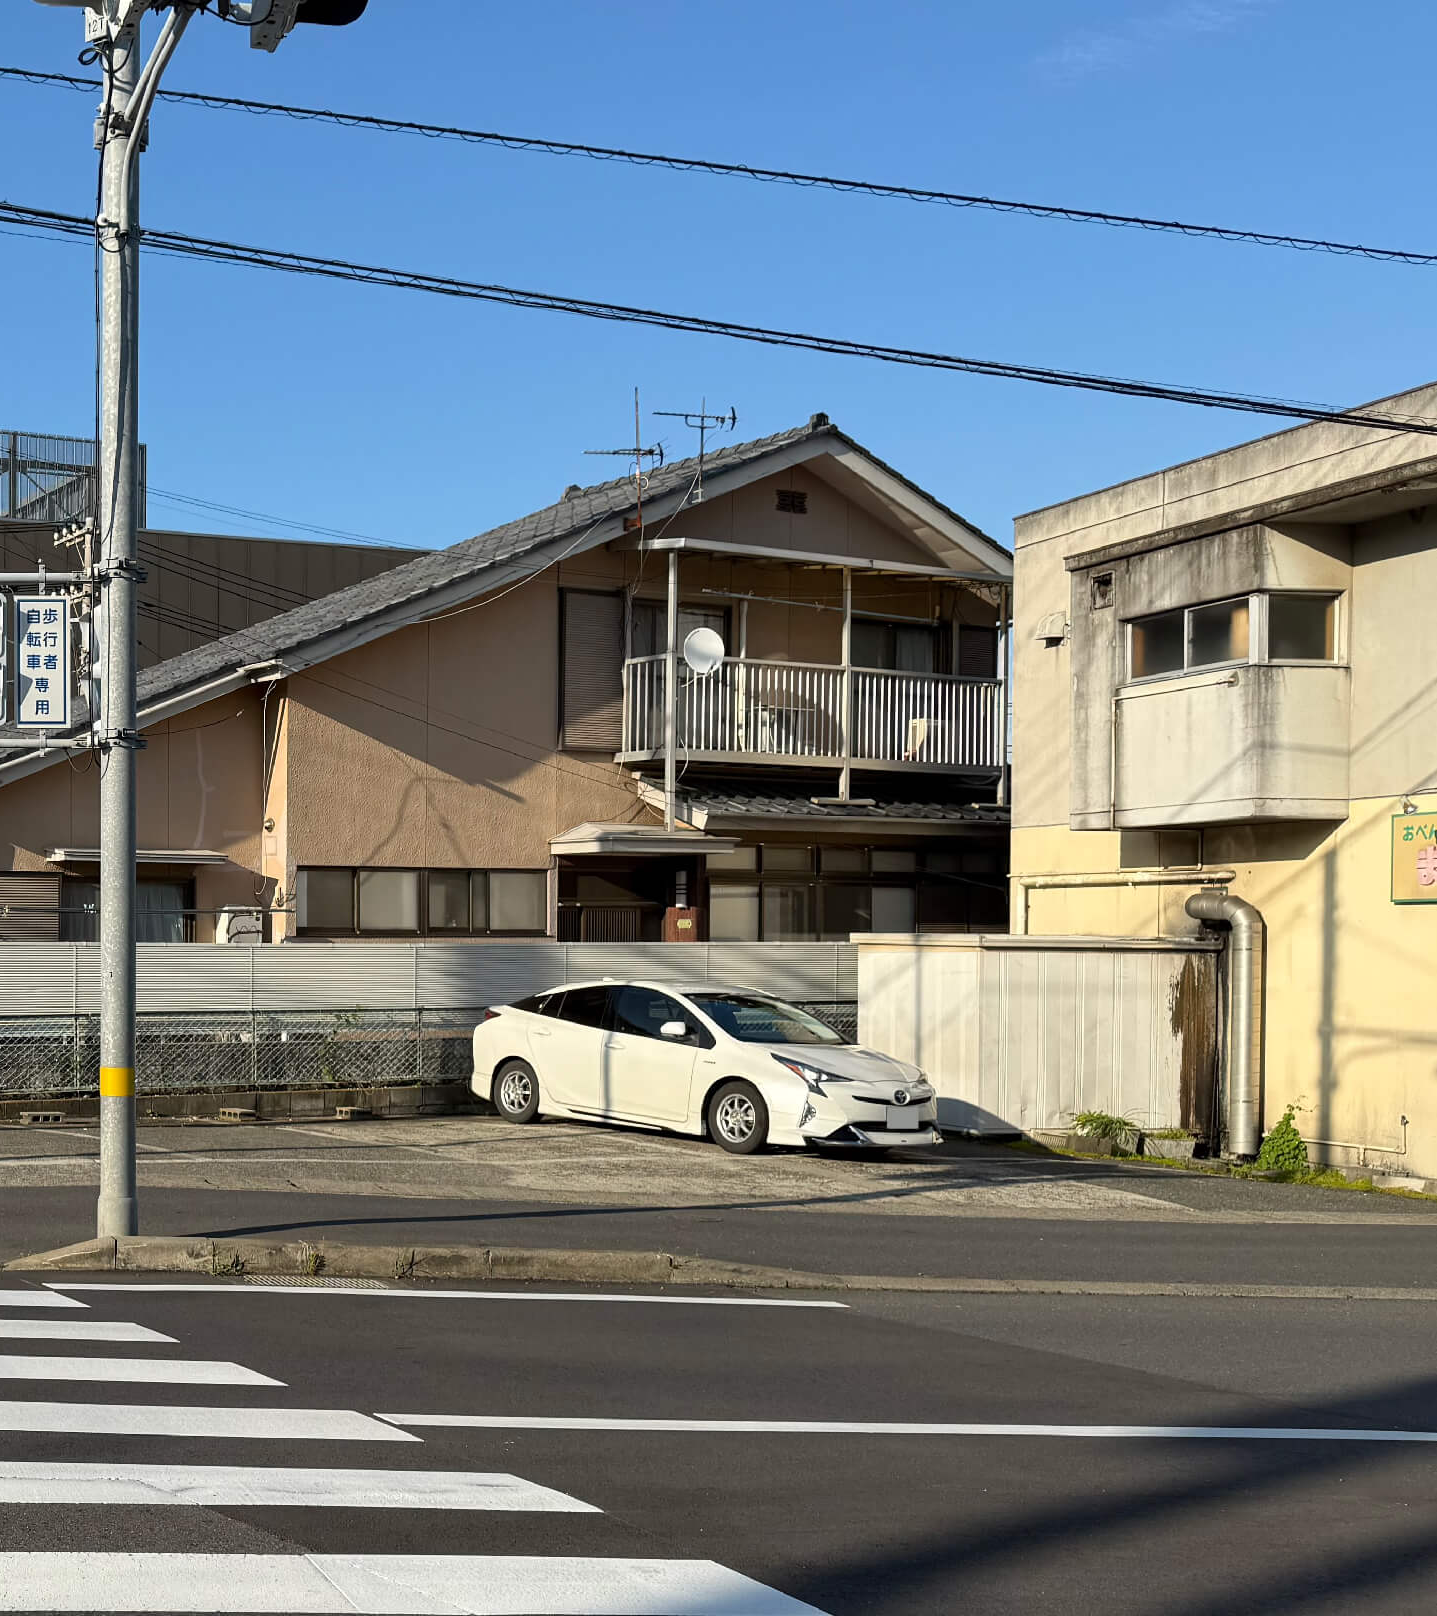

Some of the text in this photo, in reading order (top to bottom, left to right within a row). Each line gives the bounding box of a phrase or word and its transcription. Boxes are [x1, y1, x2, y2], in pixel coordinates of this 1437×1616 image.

[26, 609, 42, 669] 自転車
[43, 608, 58, 670] 歩行者
[35, 677, 50, 715] 専用
